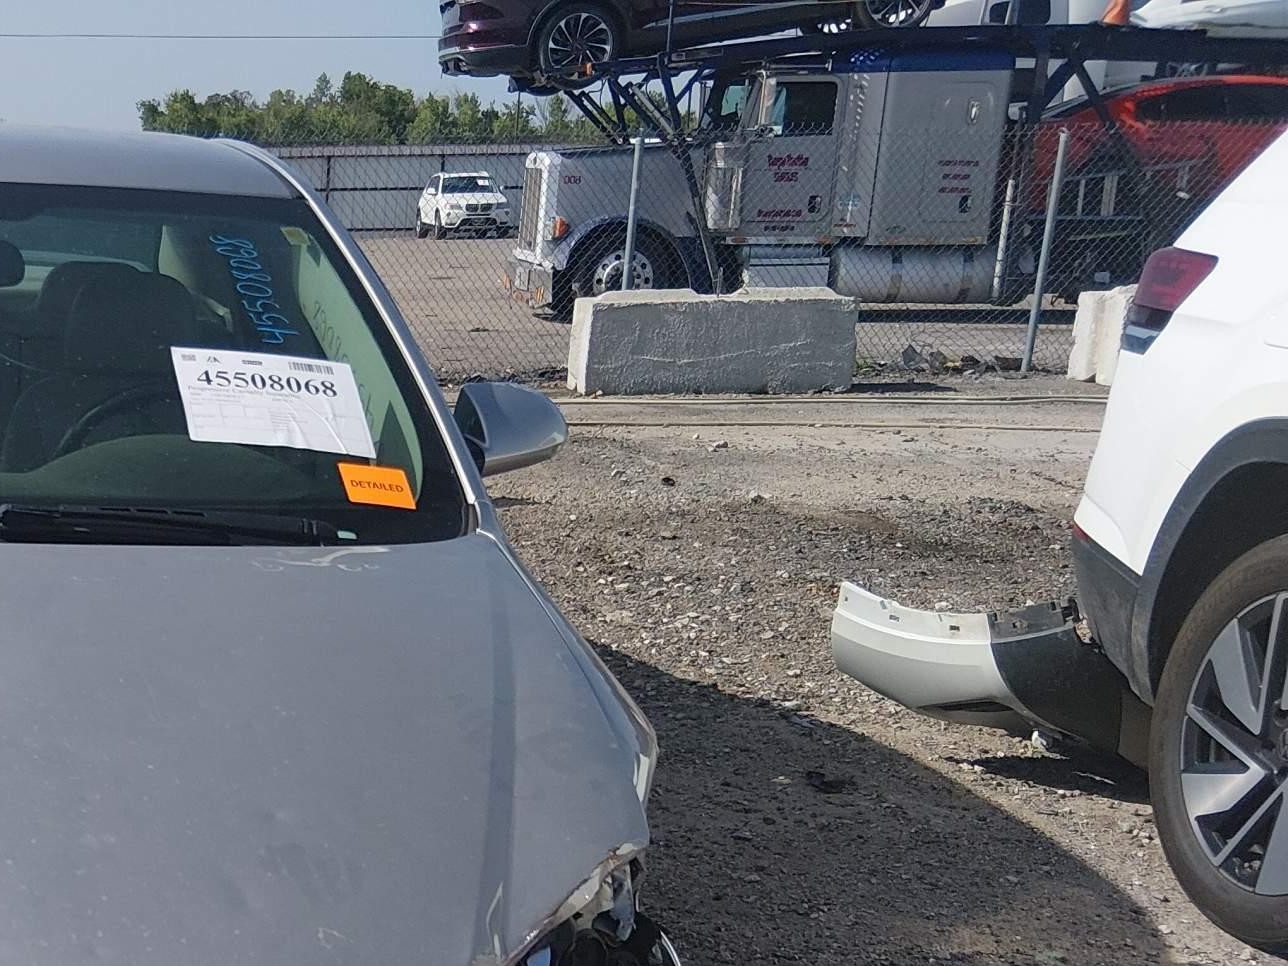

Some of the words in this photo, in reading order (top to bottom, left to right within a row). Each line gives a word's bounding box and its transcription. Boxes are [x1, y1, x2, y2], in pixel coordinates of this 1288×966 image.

[209, 234, 300, 344] 45508068
[197, 370, 338, 397] 45508068
[350, 480, 404, 493] DETAILED
